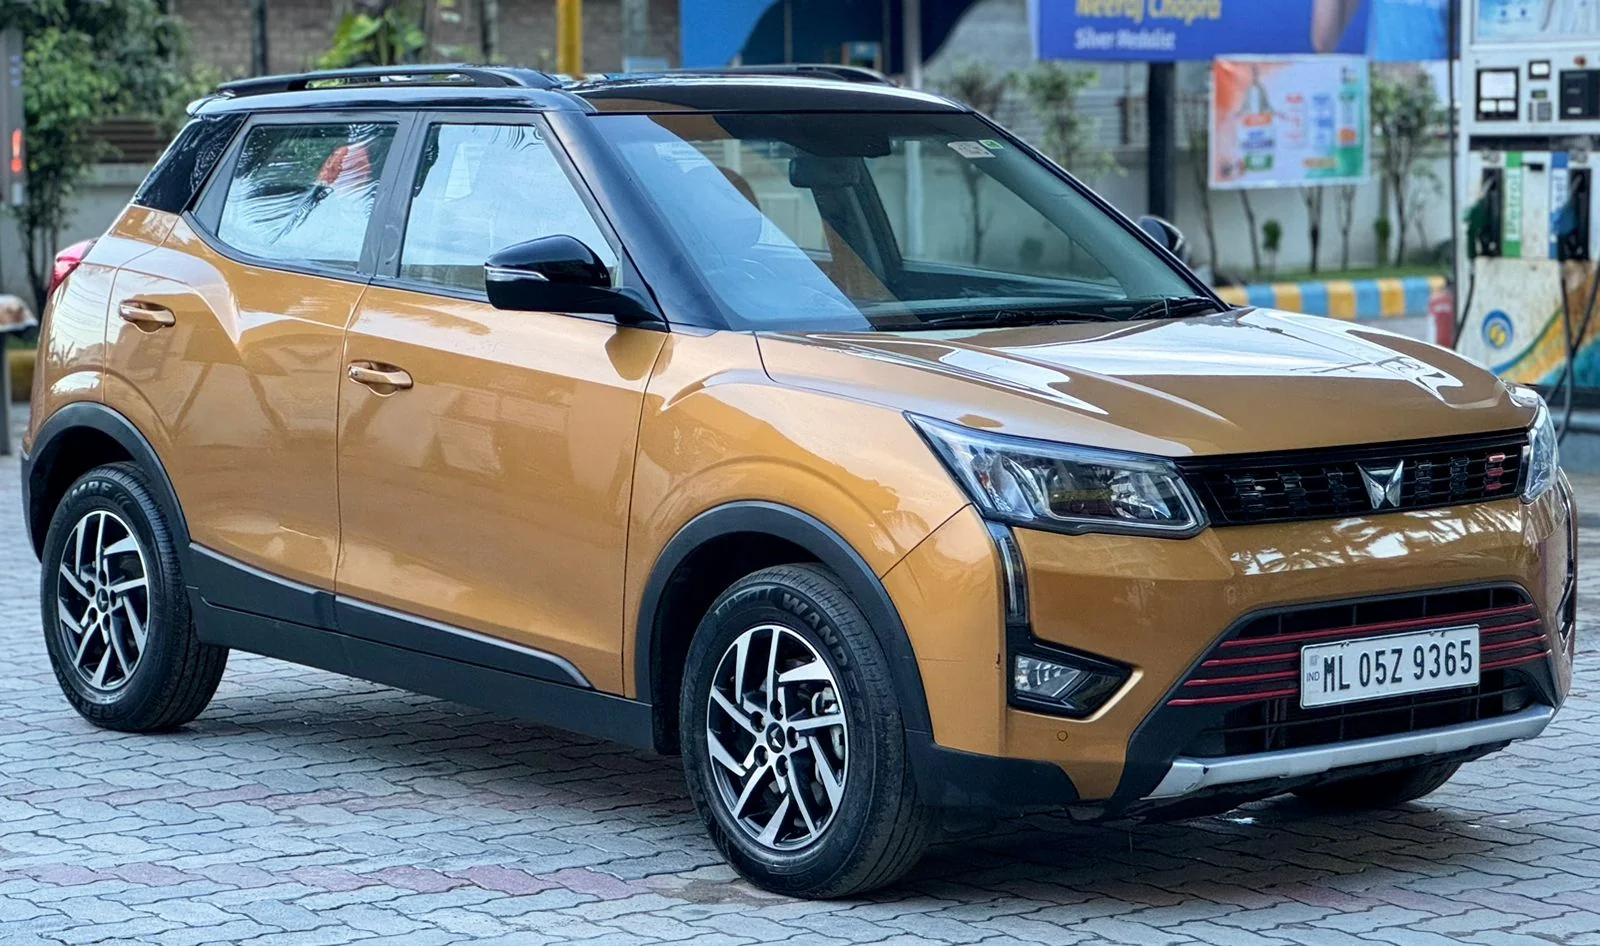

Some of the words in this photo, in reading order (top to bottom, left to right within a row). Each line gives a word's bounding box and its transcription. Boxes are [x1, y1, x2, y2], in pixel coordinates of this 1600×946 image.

[1305, 671, 1320, 682] IND
[1323, 655, 1350, 692] ML
[1359, 648, 1403, 688] 05Z
[1413, 640, 1473, 680] 9365
